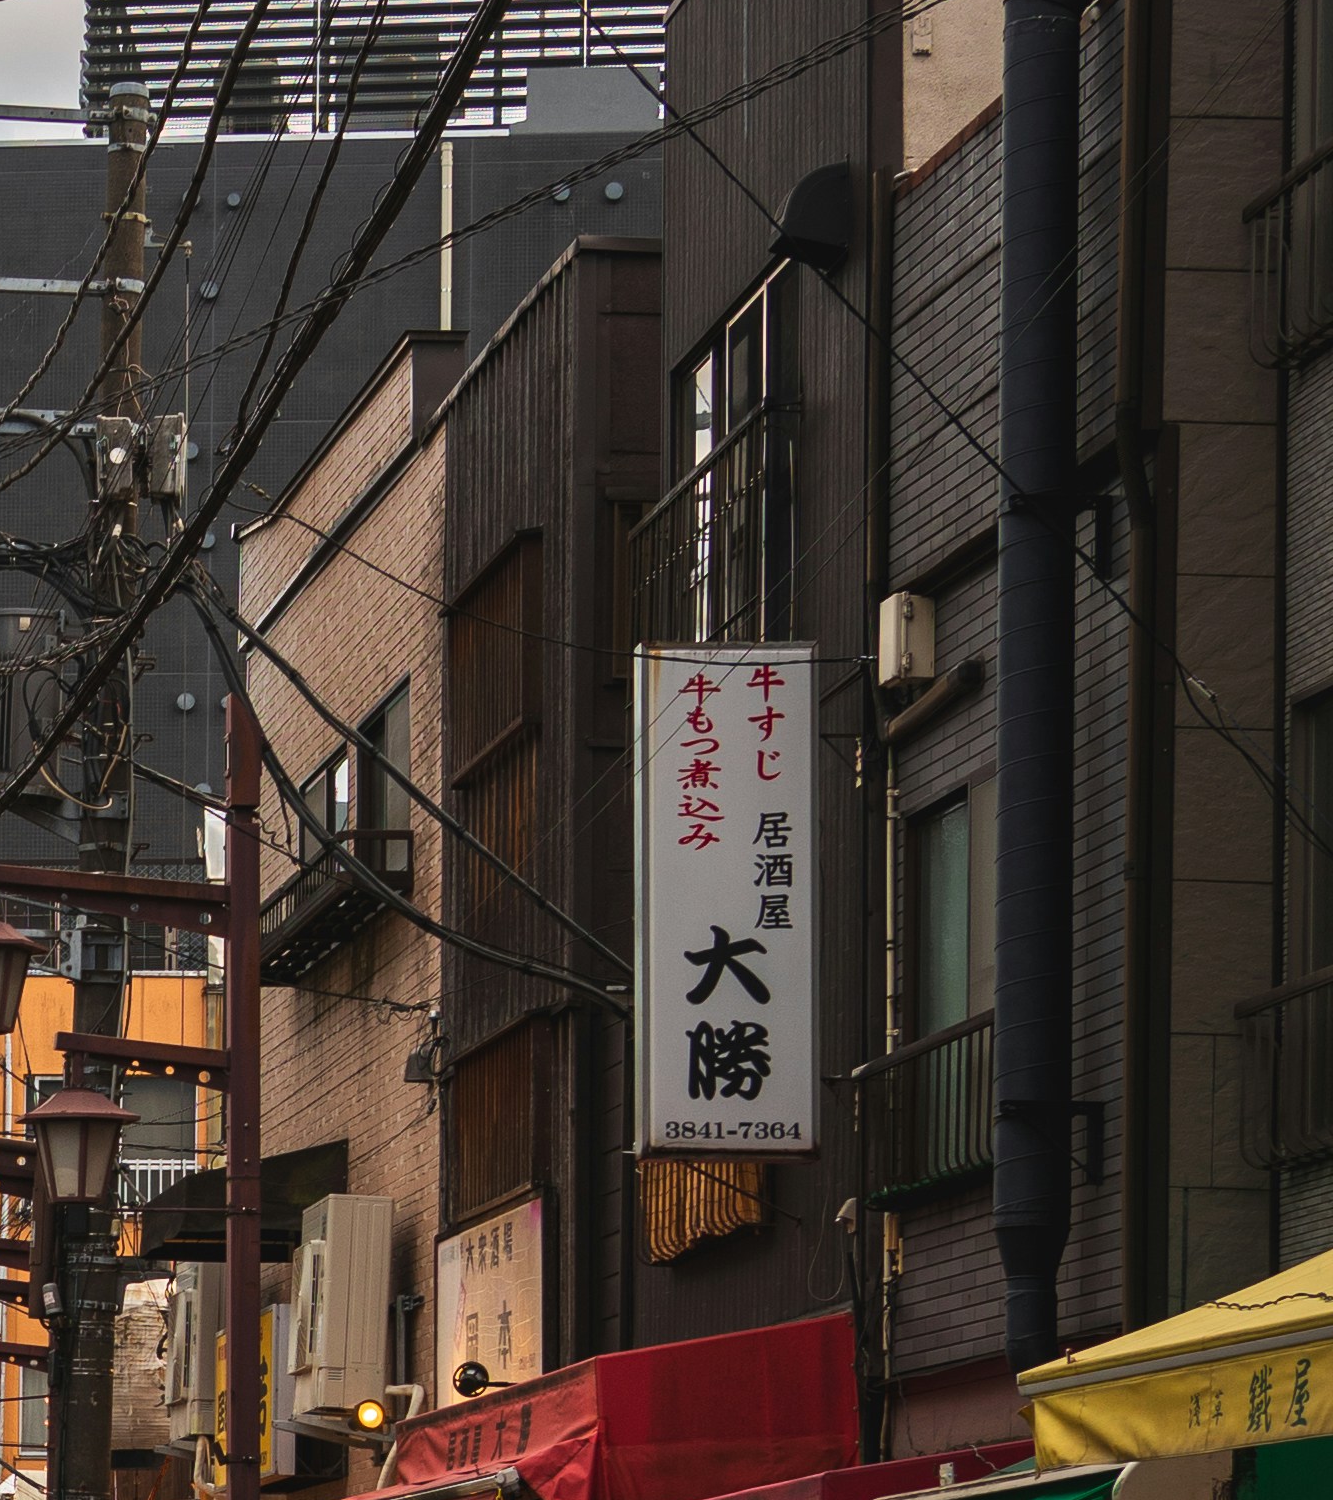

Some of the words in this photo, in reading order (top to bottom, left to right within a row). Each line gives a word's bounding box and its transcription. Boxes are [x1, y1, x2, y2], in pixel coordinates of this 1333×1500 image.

[676, 673, 725, 851] 牛もつ煮込み
[745, 663, 786, 783] 牛すじ
[752, 812, 794, 930] 居酒屋
[683, 925, 773, 1102] 大勝
[665, 1120, 802, 1141] 3841-7364
